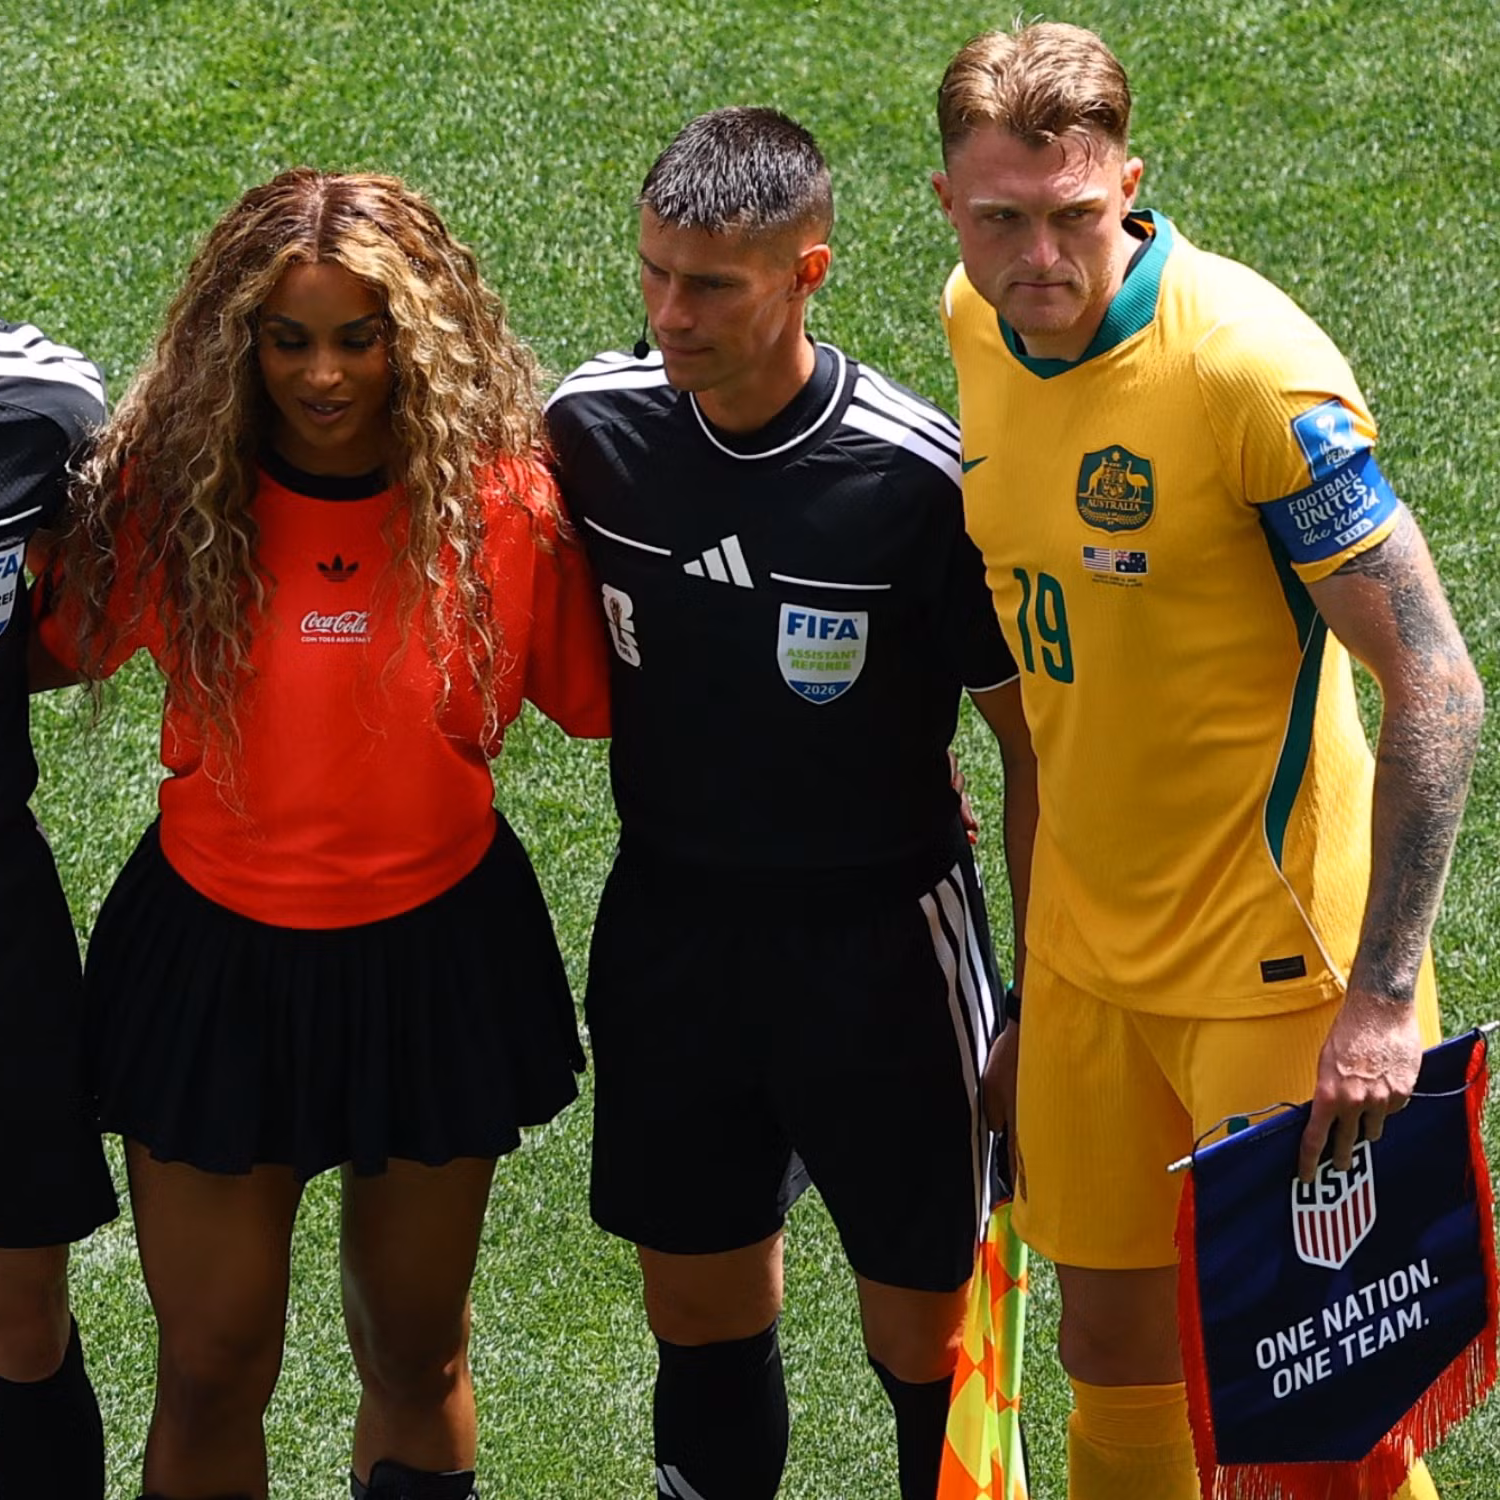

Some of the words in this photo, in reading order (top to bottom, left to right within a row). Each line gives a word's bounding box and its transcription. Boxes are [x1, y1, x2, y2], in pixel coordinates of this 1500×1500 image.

[1288, 468, 1358, 515] FOOTBALL
[1294, 478, 1367, 530] UNITES
[1303, 527, 1331, 546] the
[1333, 488, 1380, 531] World
[1339, 520, 1371, 543] FIFA
[787, 611, 860, 641] FIFA
[1012, 567, 1075, 684] 19
[787, 648, 858, 660] ASSISTANT
[791, 659, 852, 671] REFEREE
[803, 684, 837, 695] 2026
[1256, 1316, 1317, 1370] ONE
[1321, 1258, 1439, 1339] NATION.
[1273, 1347, 1333, 1399] ONE
[1338, 1301, 1430, 1366] TEAM.
